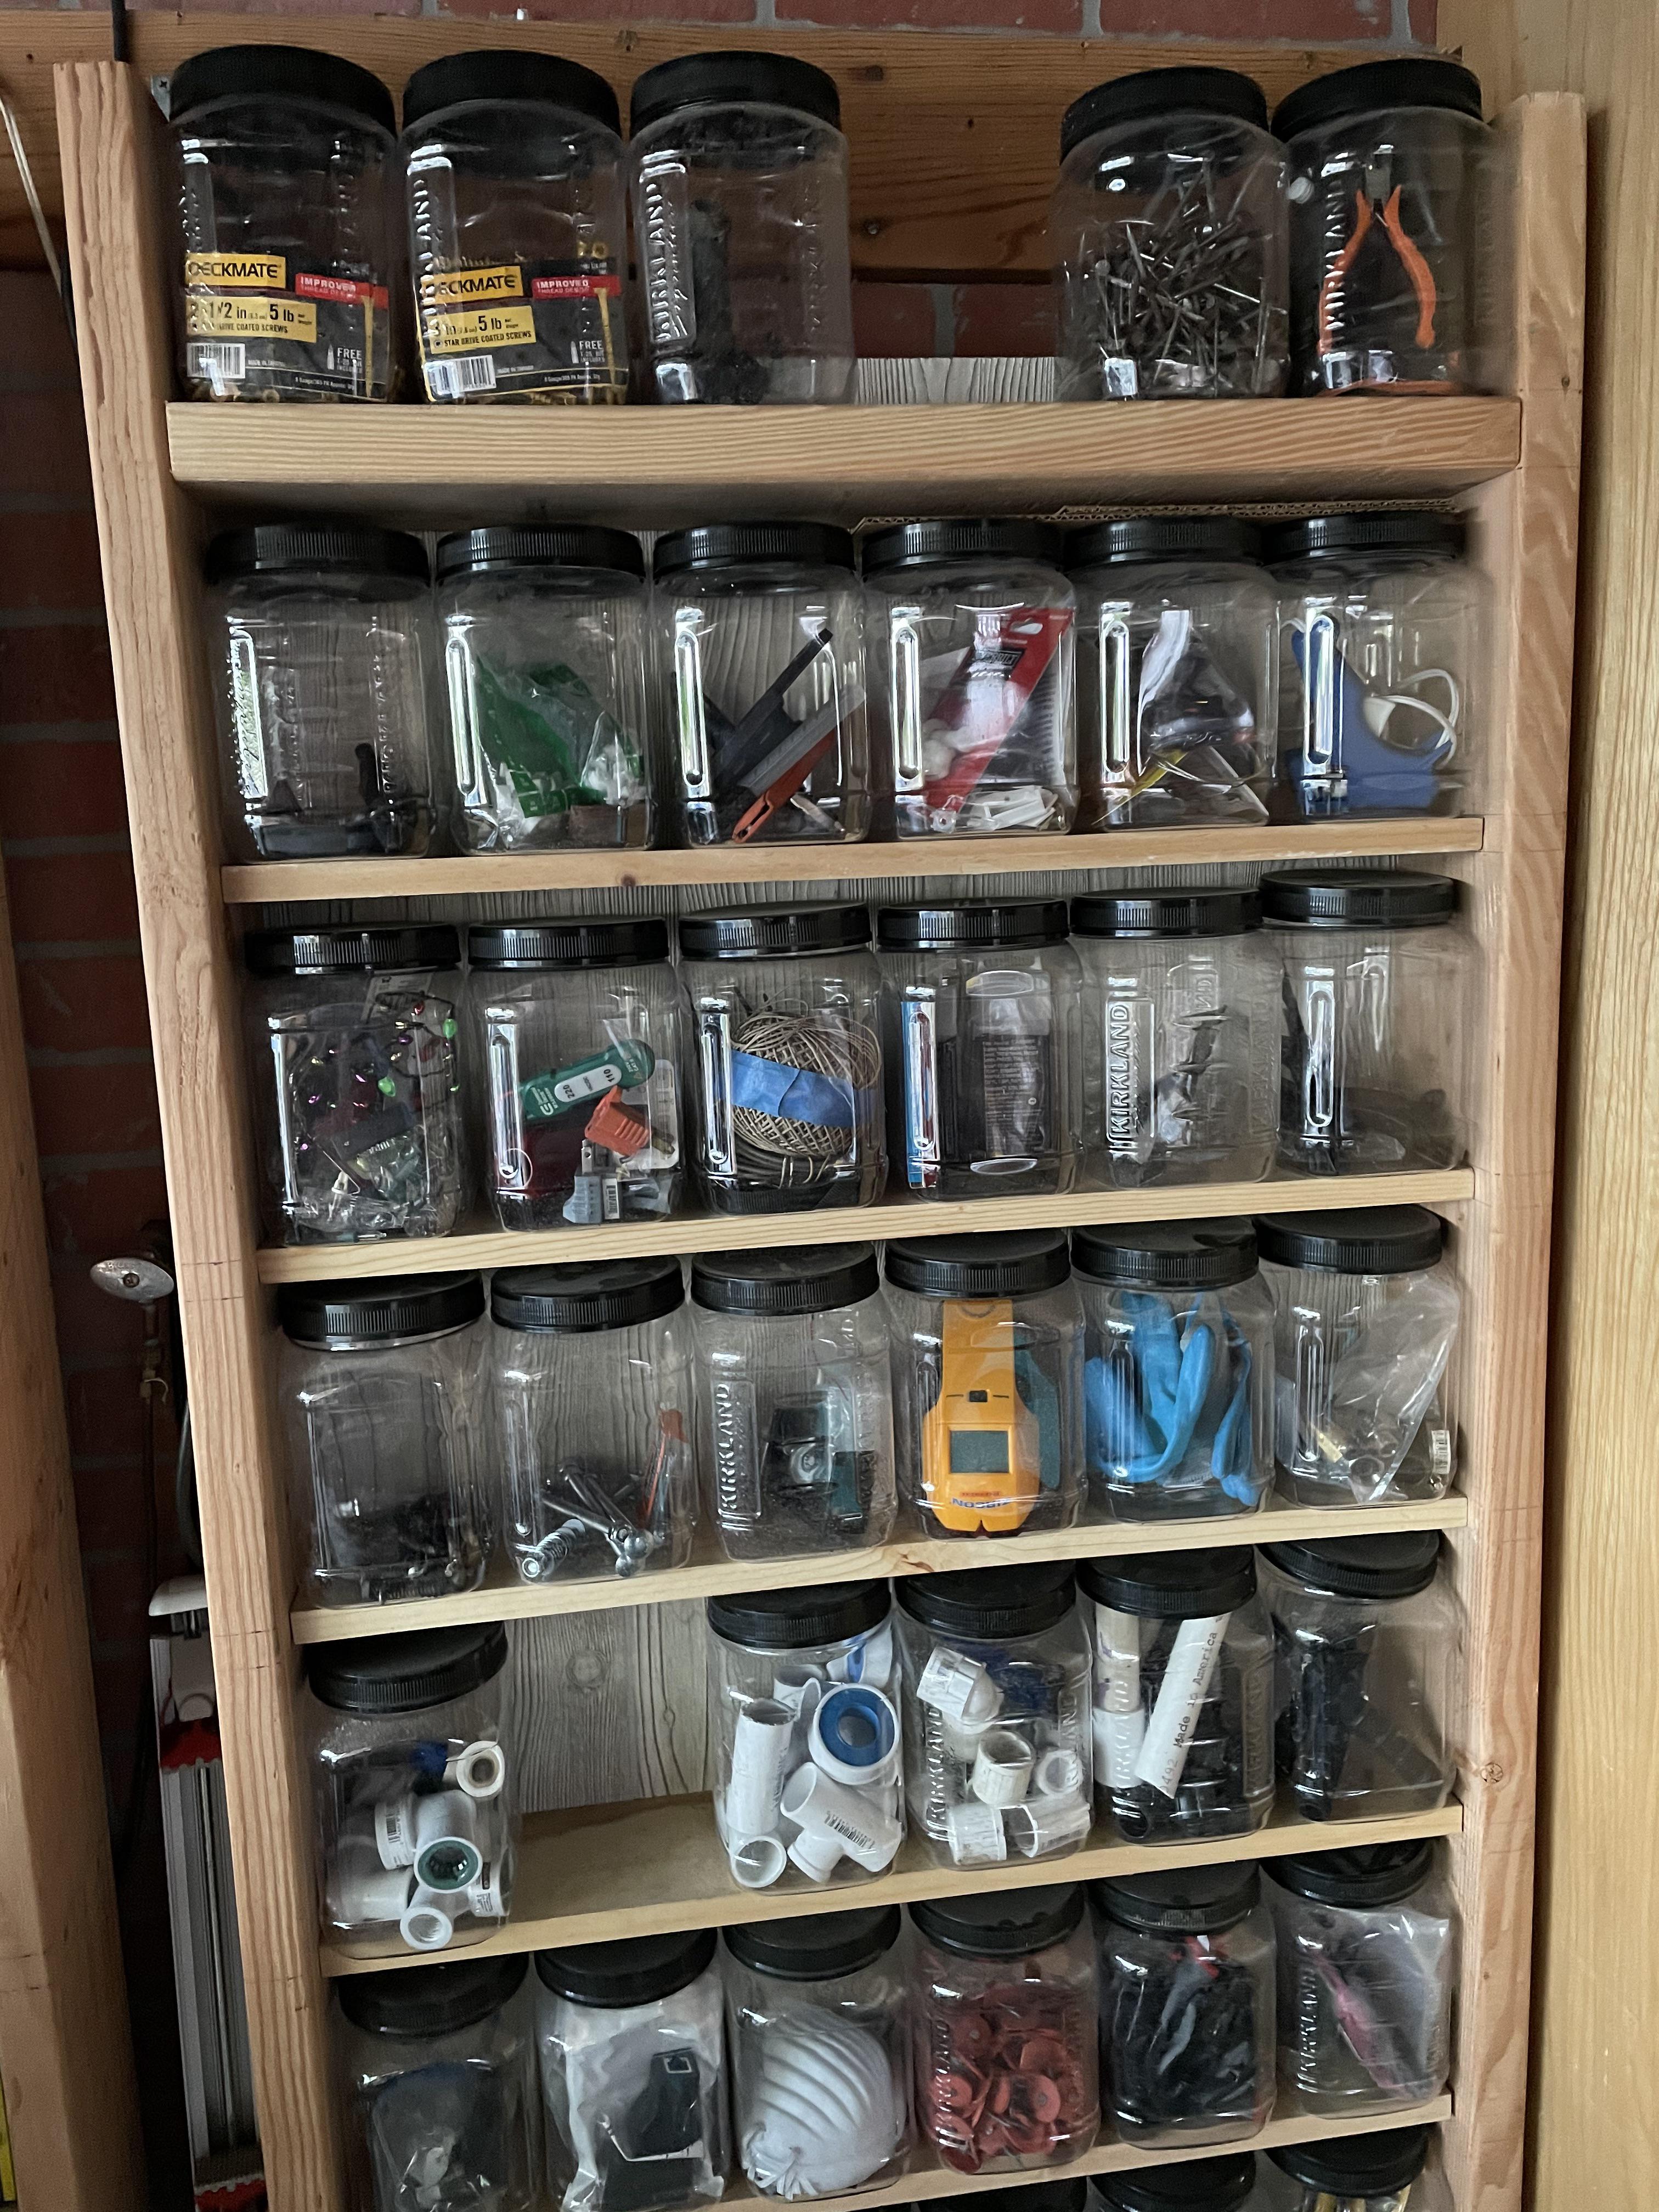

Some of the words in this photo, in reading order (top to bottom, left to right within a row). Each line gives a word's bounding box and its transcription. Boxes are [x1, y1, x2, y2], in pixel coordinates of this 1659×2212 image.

[189, 262, 278, 278] DECKMATE
[426, 275, 517, 296] ECKMATE
[270, 304, 279, 320] 5
[283, 308, 294, 322] lb
[261, 324, 288, 334] SCREWS
[478, 315, 488, 331] 5
[490, 318, 502, 330] lb
[444, 338, 460, 347] STAR
[481, 332, 504, 343] COATED
[506, 330, 532, 341] SCREWS
[579, 340, 602, 351] FREE
[337, 347, 362, 360] FREE
[603, 1069, 615, 1082] 110
[1110, 1004, 1130, 1133] KIRKLAND
[563, 1084, 575, 1098] 220
[716, 1383, 737, 1510] KIRKLAND
[1173, 1716, 1191, 1748] Made
[1192, 1632, 1218, 1686] America
